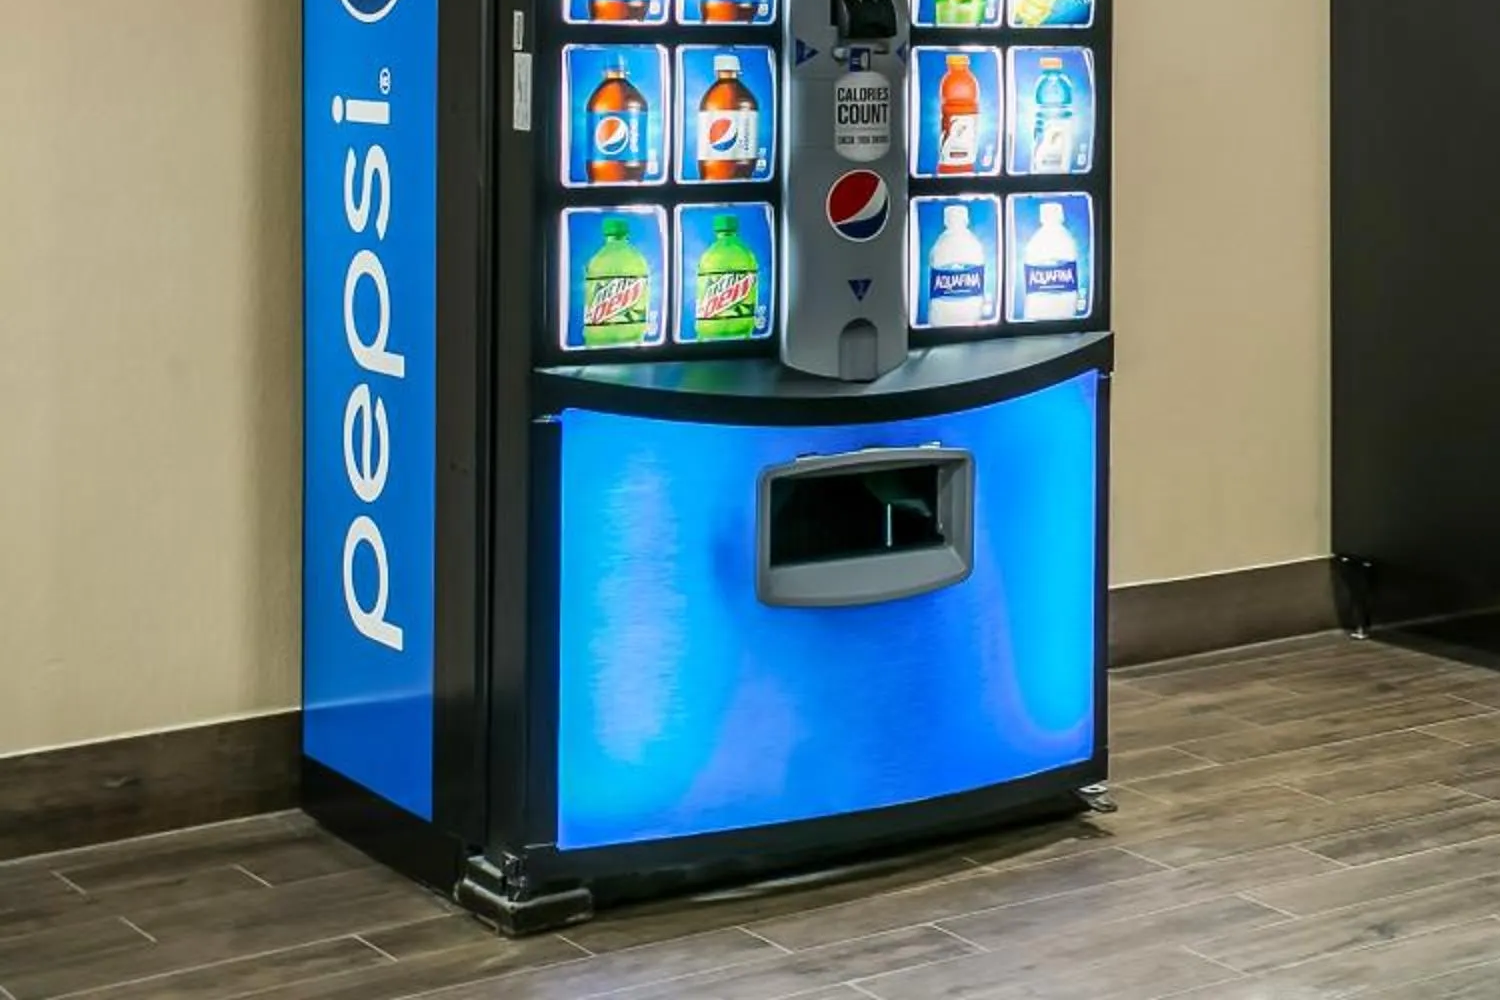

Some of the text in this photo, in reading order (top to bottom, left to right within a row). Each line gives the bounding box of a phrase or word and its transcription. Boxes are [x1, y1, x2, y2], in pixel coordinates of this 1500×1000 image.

[837, 87, 889, 102] CALORIES
[837, 103, 889, 125] COUNT
[934, 269, 981, 292] AQUAFINA
[1029, 267, 1074, 286] AQUAFINA
[331, 95, 405, 651] pepsi
